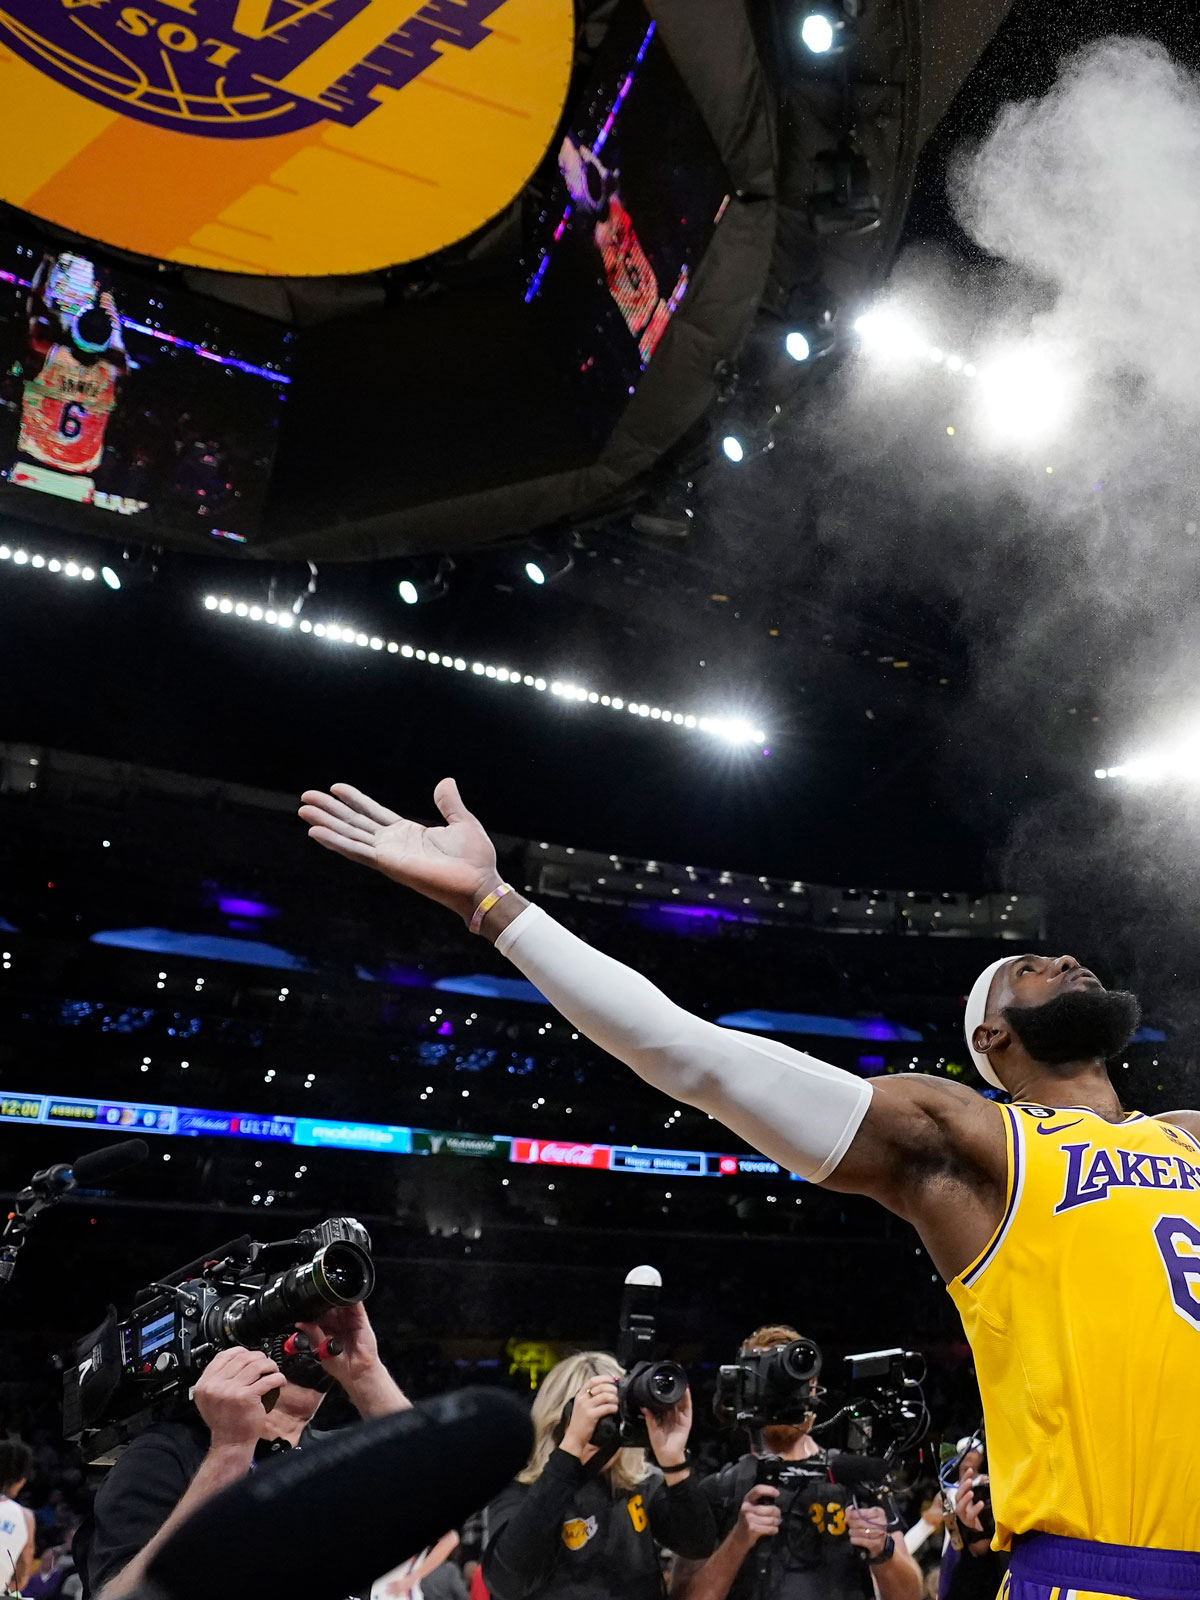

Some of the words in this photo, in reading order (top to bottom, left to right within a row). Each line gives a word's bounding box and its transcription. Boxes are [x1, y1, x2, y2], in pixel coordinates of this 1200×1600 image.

[115, 8, 241, 68] LOS
[59, 402, 87, 438] 6
[50, 1104, 97, 1119] ASSISTS
[239, 1118, 292, 1138] ULTRA
[738, 1160, 780, 1173] TOYOTA
[627, 1495, 649, 1533] 6
